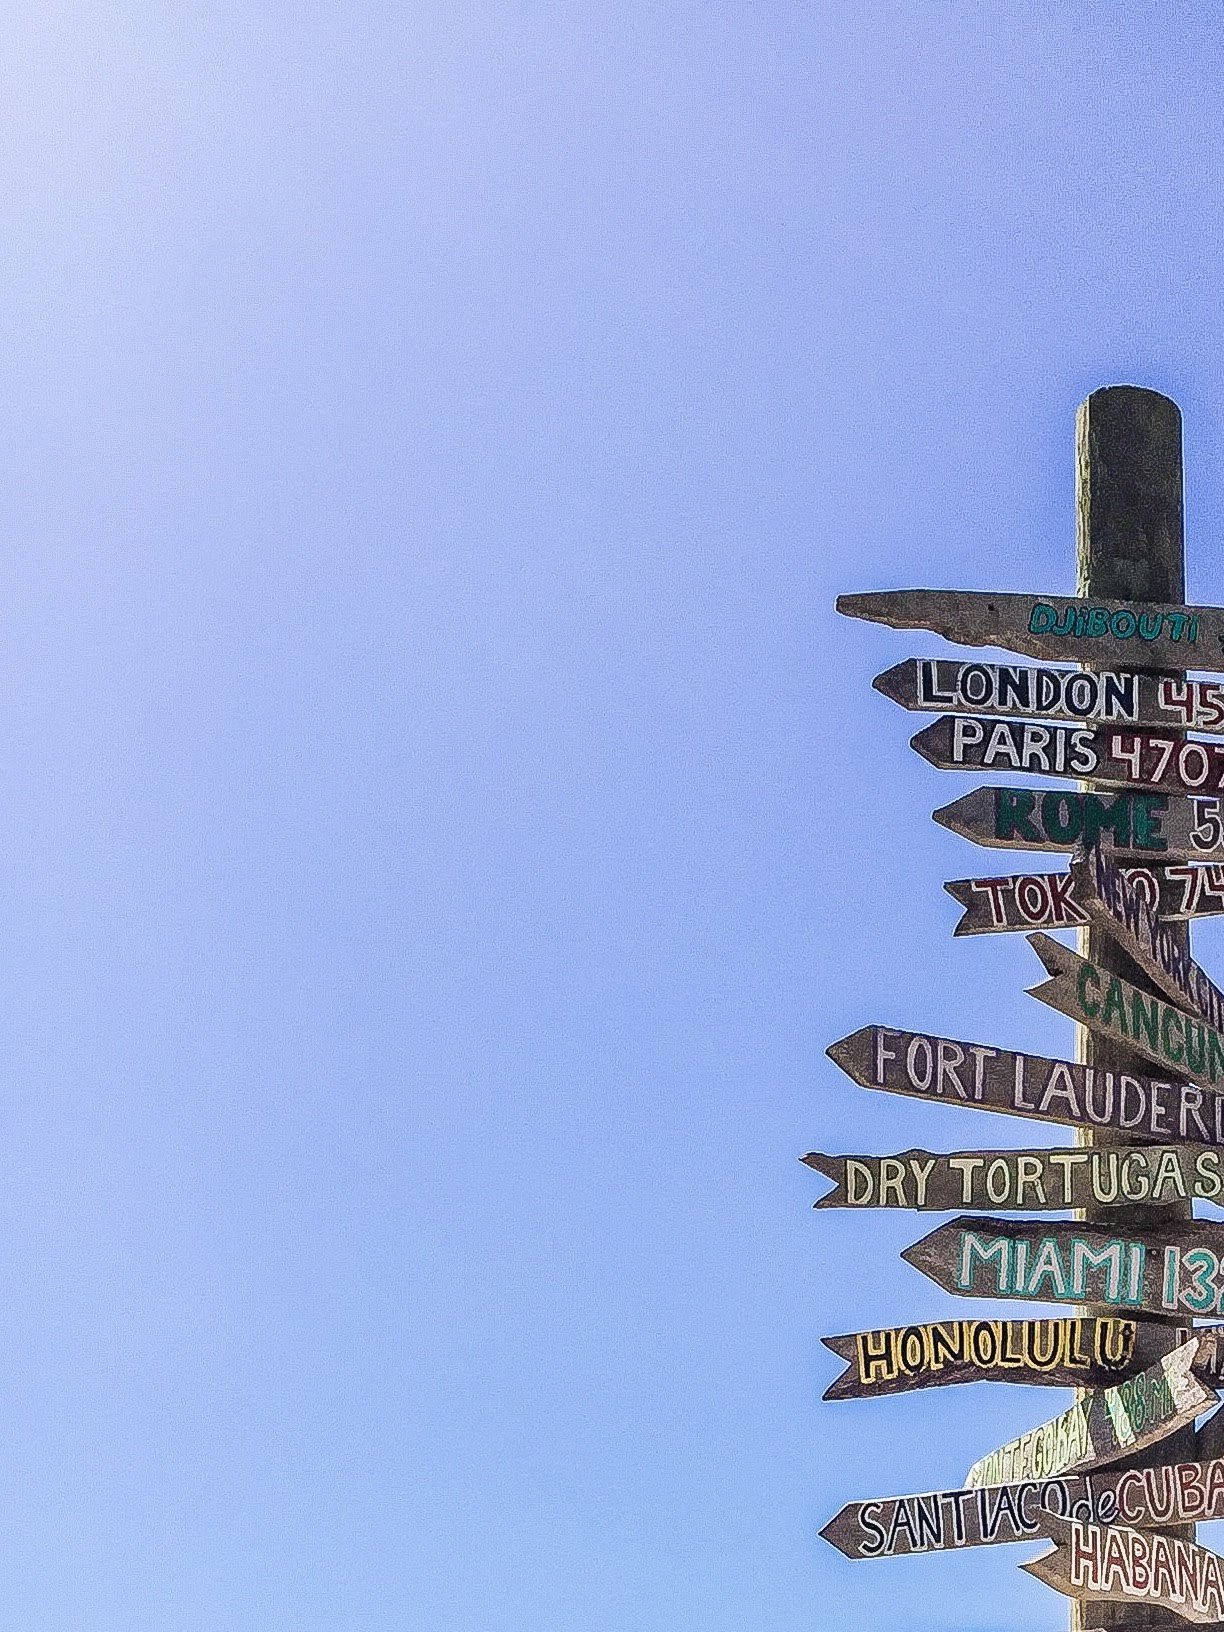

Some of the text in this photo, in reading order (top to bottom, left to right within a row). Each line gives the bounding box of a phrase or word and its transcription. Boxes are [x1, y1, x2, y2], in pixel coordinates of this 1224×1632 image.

[916, 659, 1141, 720] LONDON
[951, 718, 1100, 775] PARIS
[993, 789, 1169, 852] ROME
[972, 865, 1160, 926] TOKO
[871, 1028, 1004, 1100] FORT
[842, 1155, 937, 1208] DRY
[949, 1150, 1224, 1206] TORTUGAS
[957, 1232, 1146, 1306] MIAMI
[856, 1318, 1137, 1384] HONOLULU
